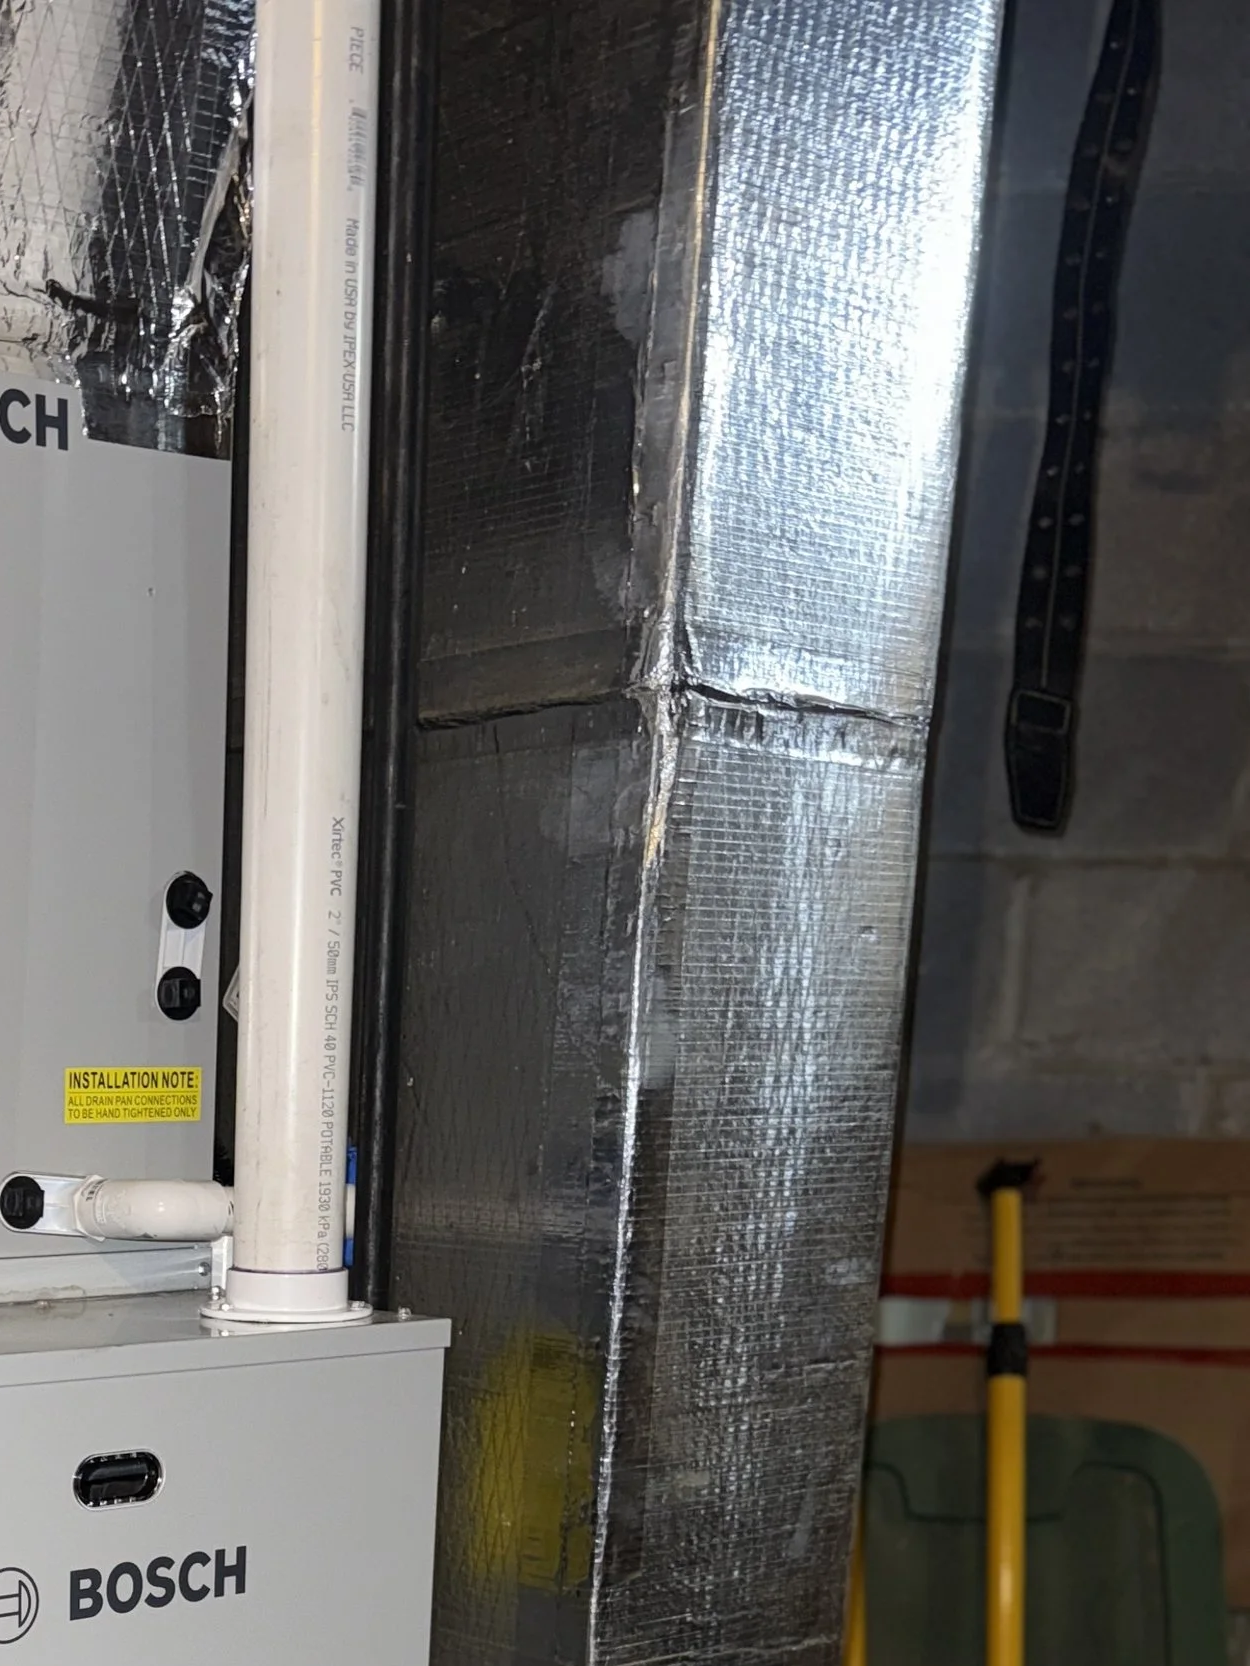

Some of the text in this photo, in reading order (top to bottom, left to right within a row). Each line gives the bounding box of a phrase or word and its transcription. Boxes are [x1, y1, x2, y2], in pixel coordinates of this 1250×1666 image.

[348, 26, 365, 75] PIECE
[340, 218, 360, 431] Made in USA by IPEX USA LLC
[330, 870, 342, 896] PVC
[326, 940, 340, 975] 50mm
[325, 979, 339, 1001] IPS
[324, 1005, 338, 1030] SCH
[324, 1035, 337, 1051] 40
[69, 1071, 198, 1089] INSTALLATION NOTE:
[321, 1055, 334, 1117] PVC-1120
[68, 1095, 197, 1106] ALL DRAIN PAN CONNECTIONS
[68, 1107, 196, 1119] TO BE HAND TIGHTENED ONLY
[319, 1121, 333, 1176] POTABLE
[318, 1181, 331, 1212] 1930
[317, 1215, 330, 1239] kPa
[70, 1545, 247, 1621] BOSCH
